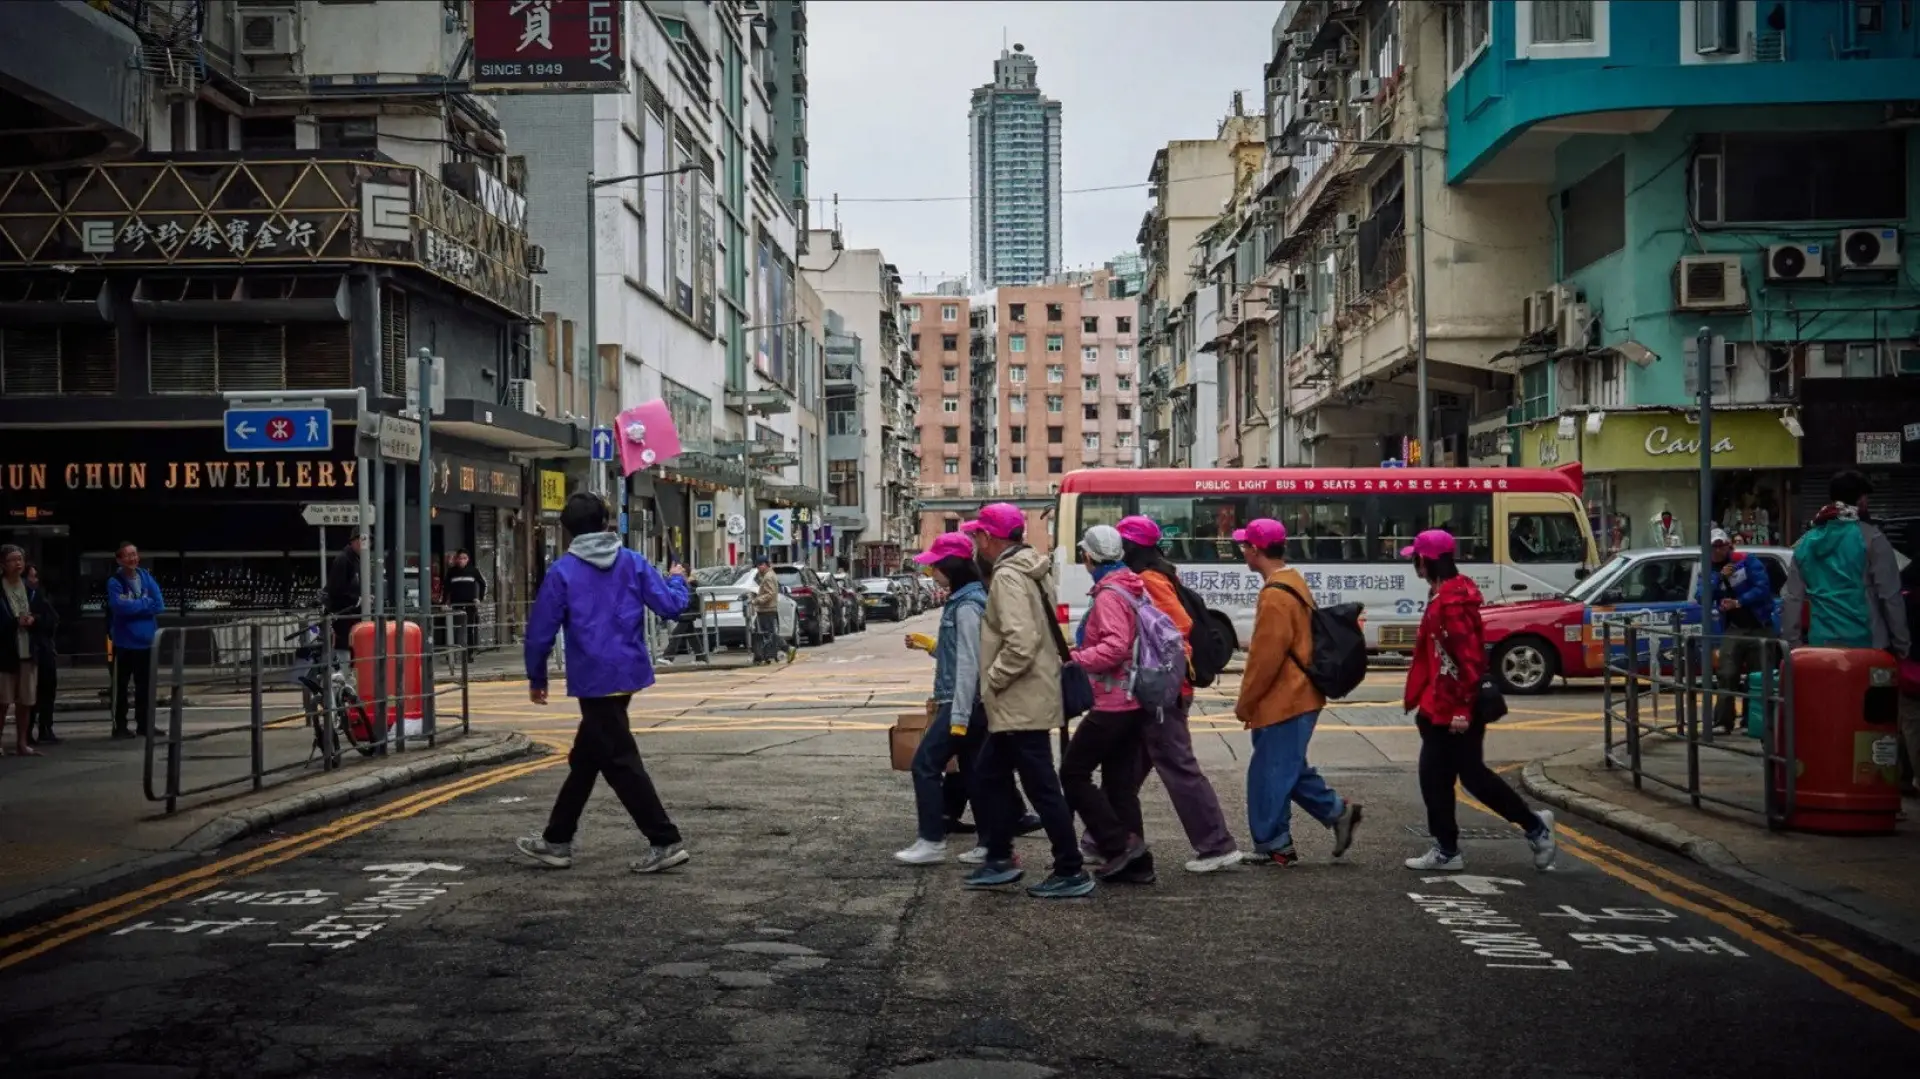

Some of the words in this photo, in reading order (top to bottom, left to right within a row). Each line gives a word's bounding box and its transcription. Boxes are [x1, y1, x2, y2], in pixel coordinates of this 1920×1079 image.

[481, 65, 522, 75] SINCE
[528, 64, 563, 75] 1949
[0, 464, 47, 490] UN
[65, 463, 147, 489] CHUN
[164, 461, 357, 489] JEWELLERY
[1195, 480, 1231, 490] PUBLIC
[1238, 480, 1268, 490] LIGHT
[1276, 480, 1296, 490] BUS
[1304, 480, 1315, 490] 19
[1322, 480, 1356, 490] SEATS
[1450, 929, 1574, 970] LOOK
